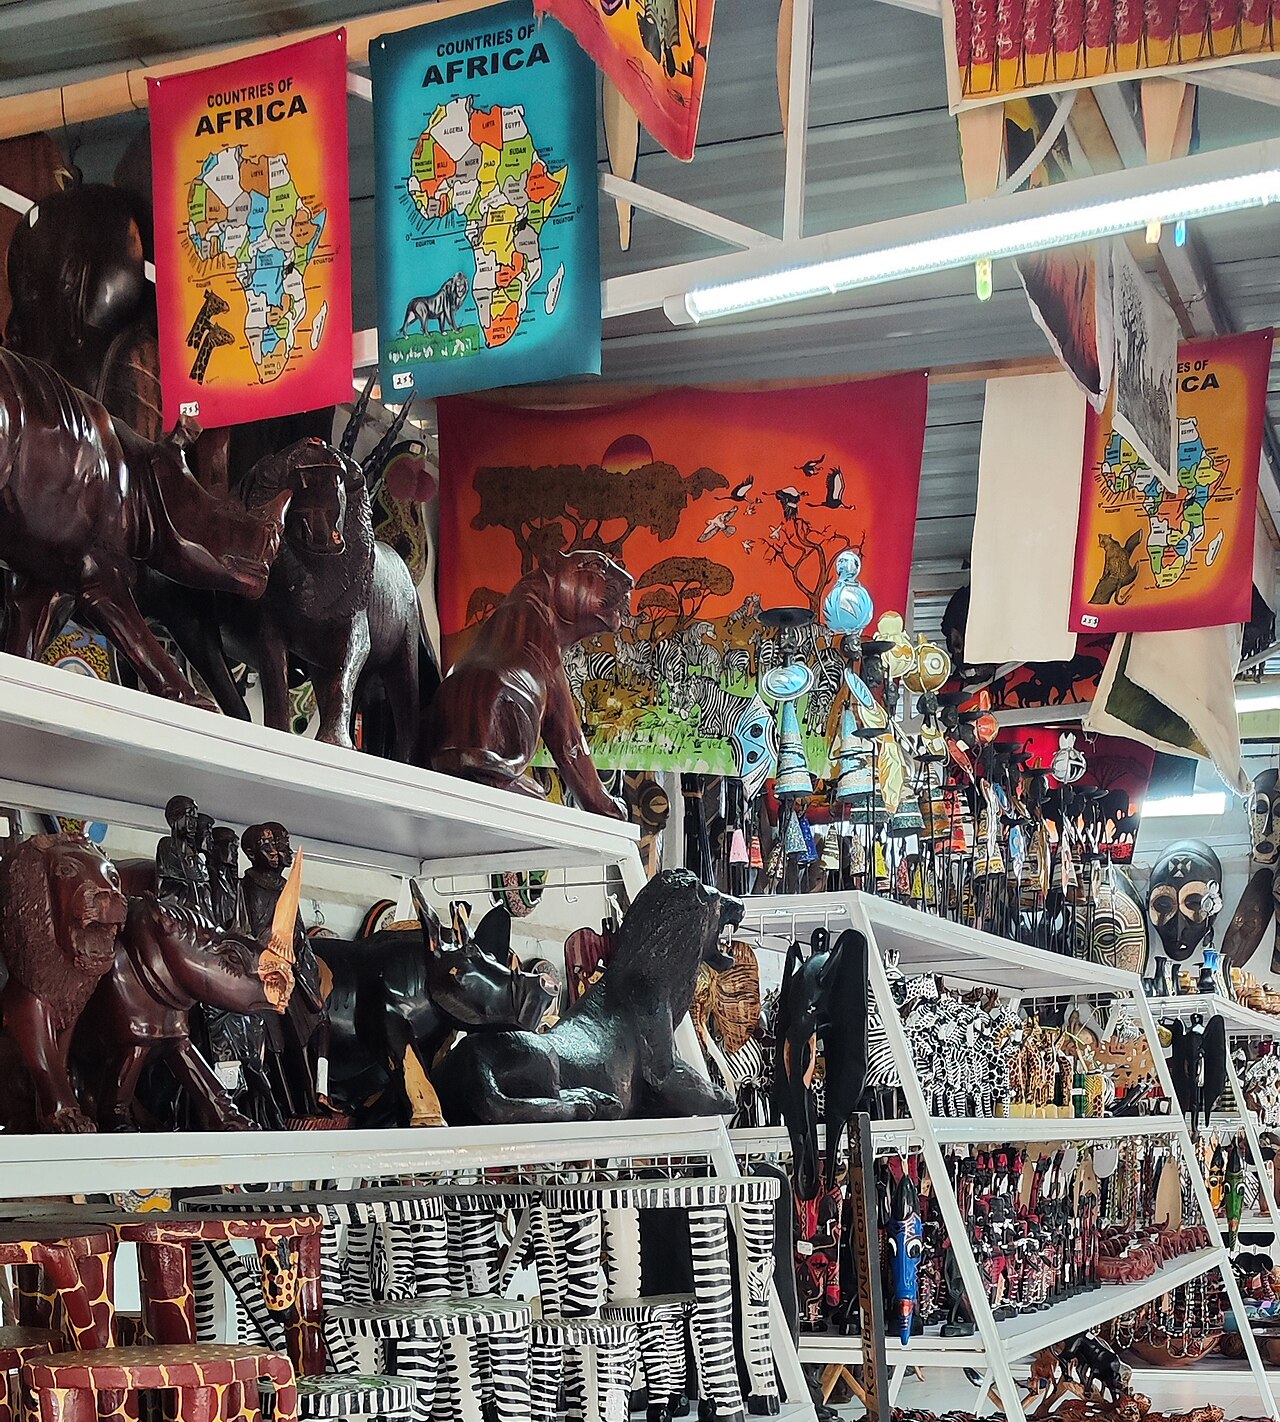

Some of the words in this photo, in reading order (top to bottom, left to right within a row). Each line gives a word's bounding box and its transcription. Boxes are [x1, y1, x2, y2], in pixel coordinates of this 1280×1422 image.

[437, 28, 513, 58] COUNTRIES
[517, 23, 536, 41] OF
[421, 42, 551, 88] AFRICA
[207, 81, 274, 109] COUNTRIES
[277, 76, 294, 93] OF
[194, 94, 308, 138] AFRICA
[443, 125, 464, 136] ALGERIA
[504, 120, 521, 130] EGYPT
[509, 146, 527, 156] SUDAN
[483, 160, 496, 169] CHAD
[552, 215, 574, 226] EQUATOR
[415, 239, 436, 248] EQUATOR
[1193, 359, 1209, 371] OF
[854, 1180, 869, 1300] Welcome
